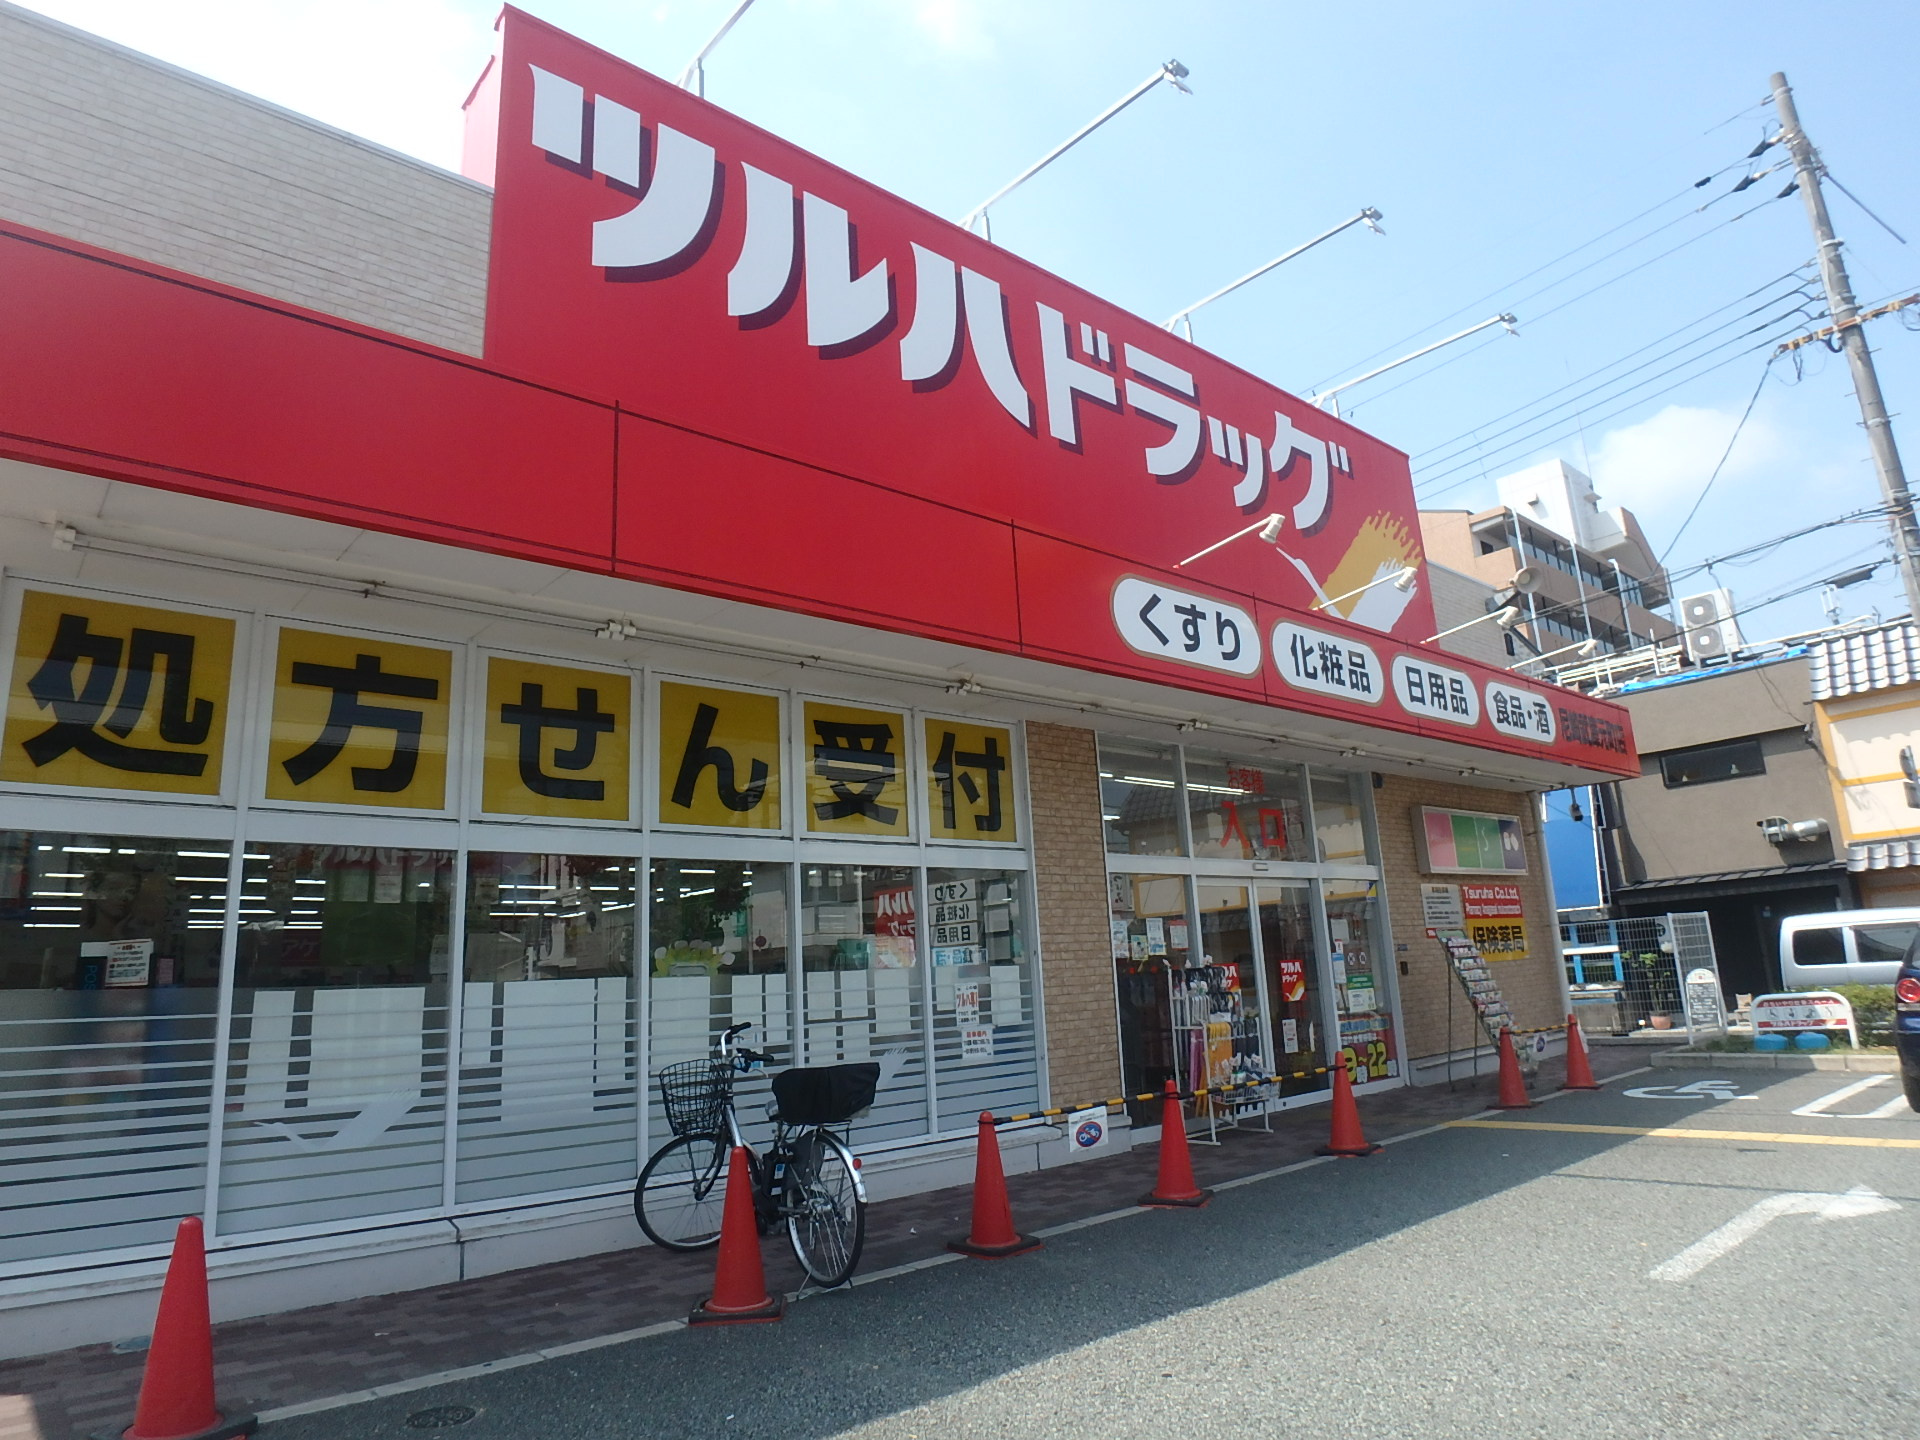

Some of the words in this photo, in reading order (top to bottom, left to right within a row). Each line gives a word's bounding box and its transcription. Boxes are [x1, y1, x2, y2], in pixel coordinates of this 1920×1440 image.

[529, 63, 1352, 534] ツルハドラッグ
[1138, 592, 1242, 661] くすり
[1290, 633, 1372, 695] 化粧品
[1405, 665, 1470, 717] 日用品
[1492, 690, 1551, 736] 食品・酒
[21, 612, 1007, 833] 処方せん受付
[1227, 766, 1265, 795] お客様
[1219, 800, 1287, 850] 入口
[1462, 886, 1494, 899] Tsuruha
[1473, 925, 1525, 955] 保険薬局
